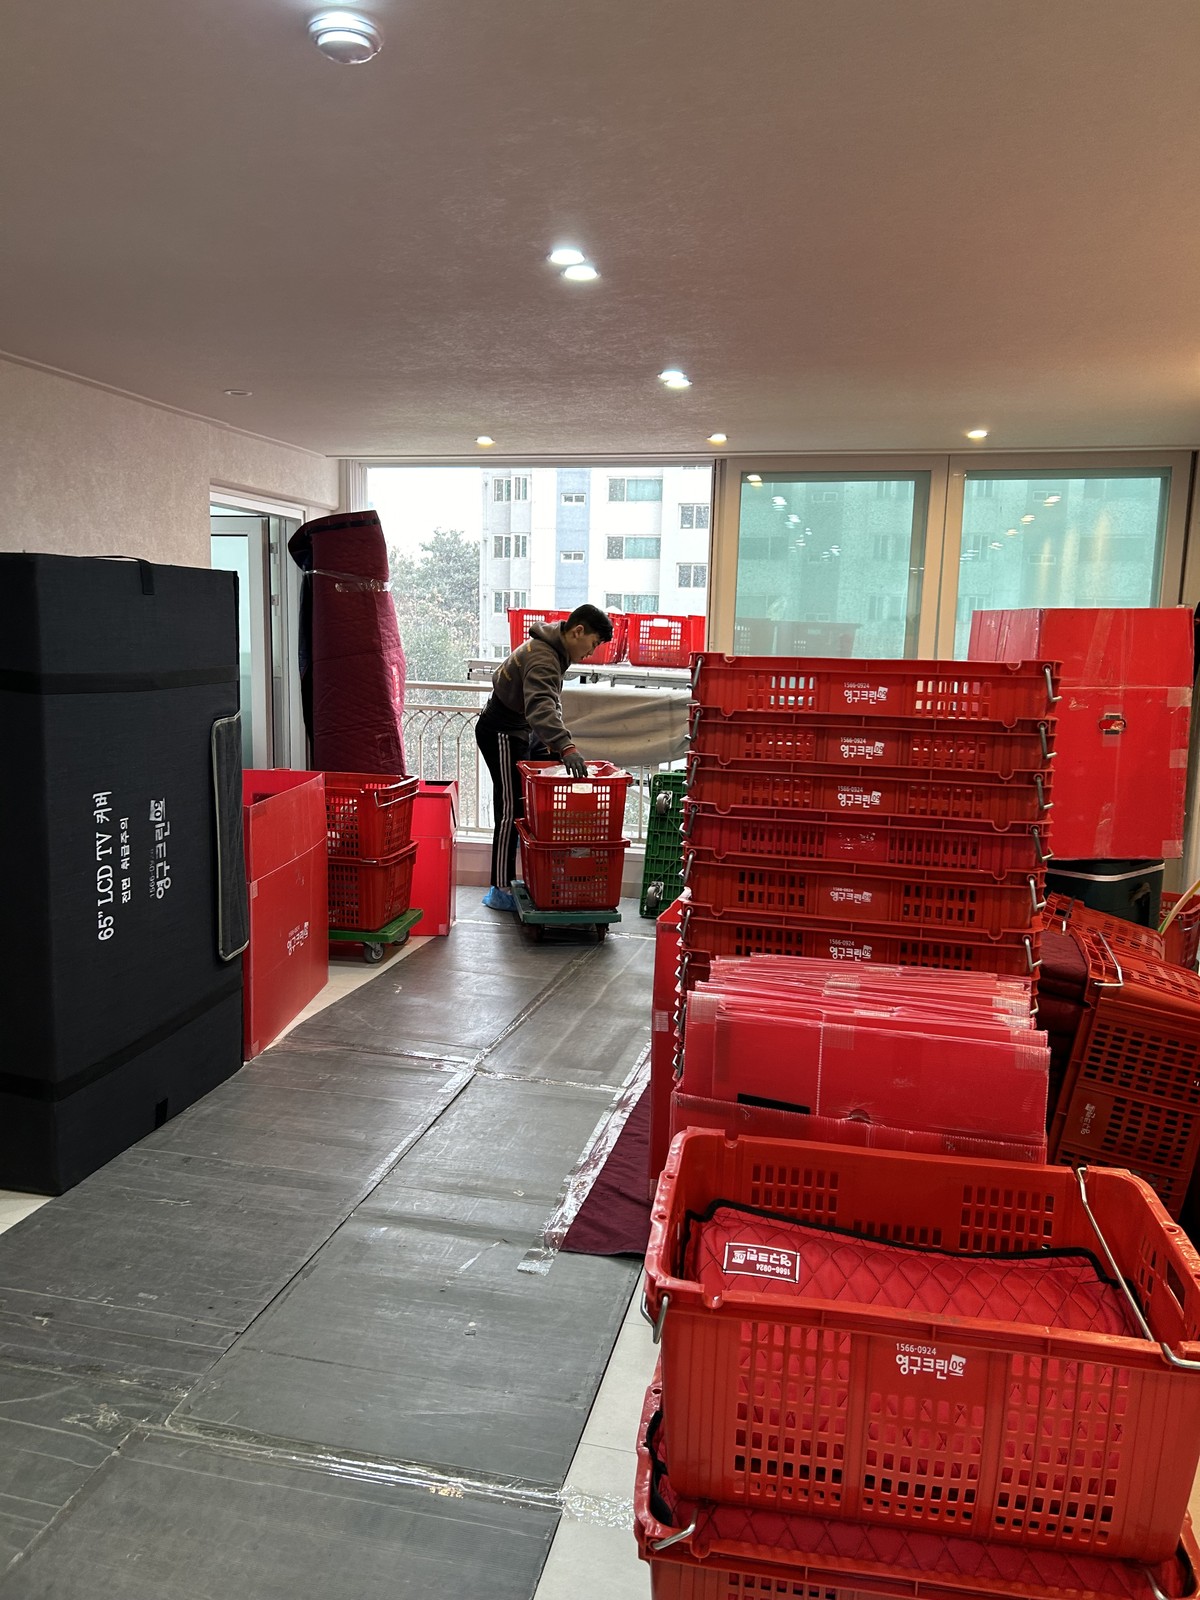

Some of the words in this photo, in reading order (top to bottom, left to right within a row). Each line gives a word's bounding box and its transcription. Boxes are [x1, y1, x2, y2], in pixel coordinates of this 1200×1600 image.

[92, 791, 112, 824] 커버
[96, 832, 112, 861] TV
[119, 817, 130, 870] 취급주의
[97, 864, 114, 906] LCD
[121, 877, 131, 904] 전면
[896, 1343, 937, 1355] 1566-0924
